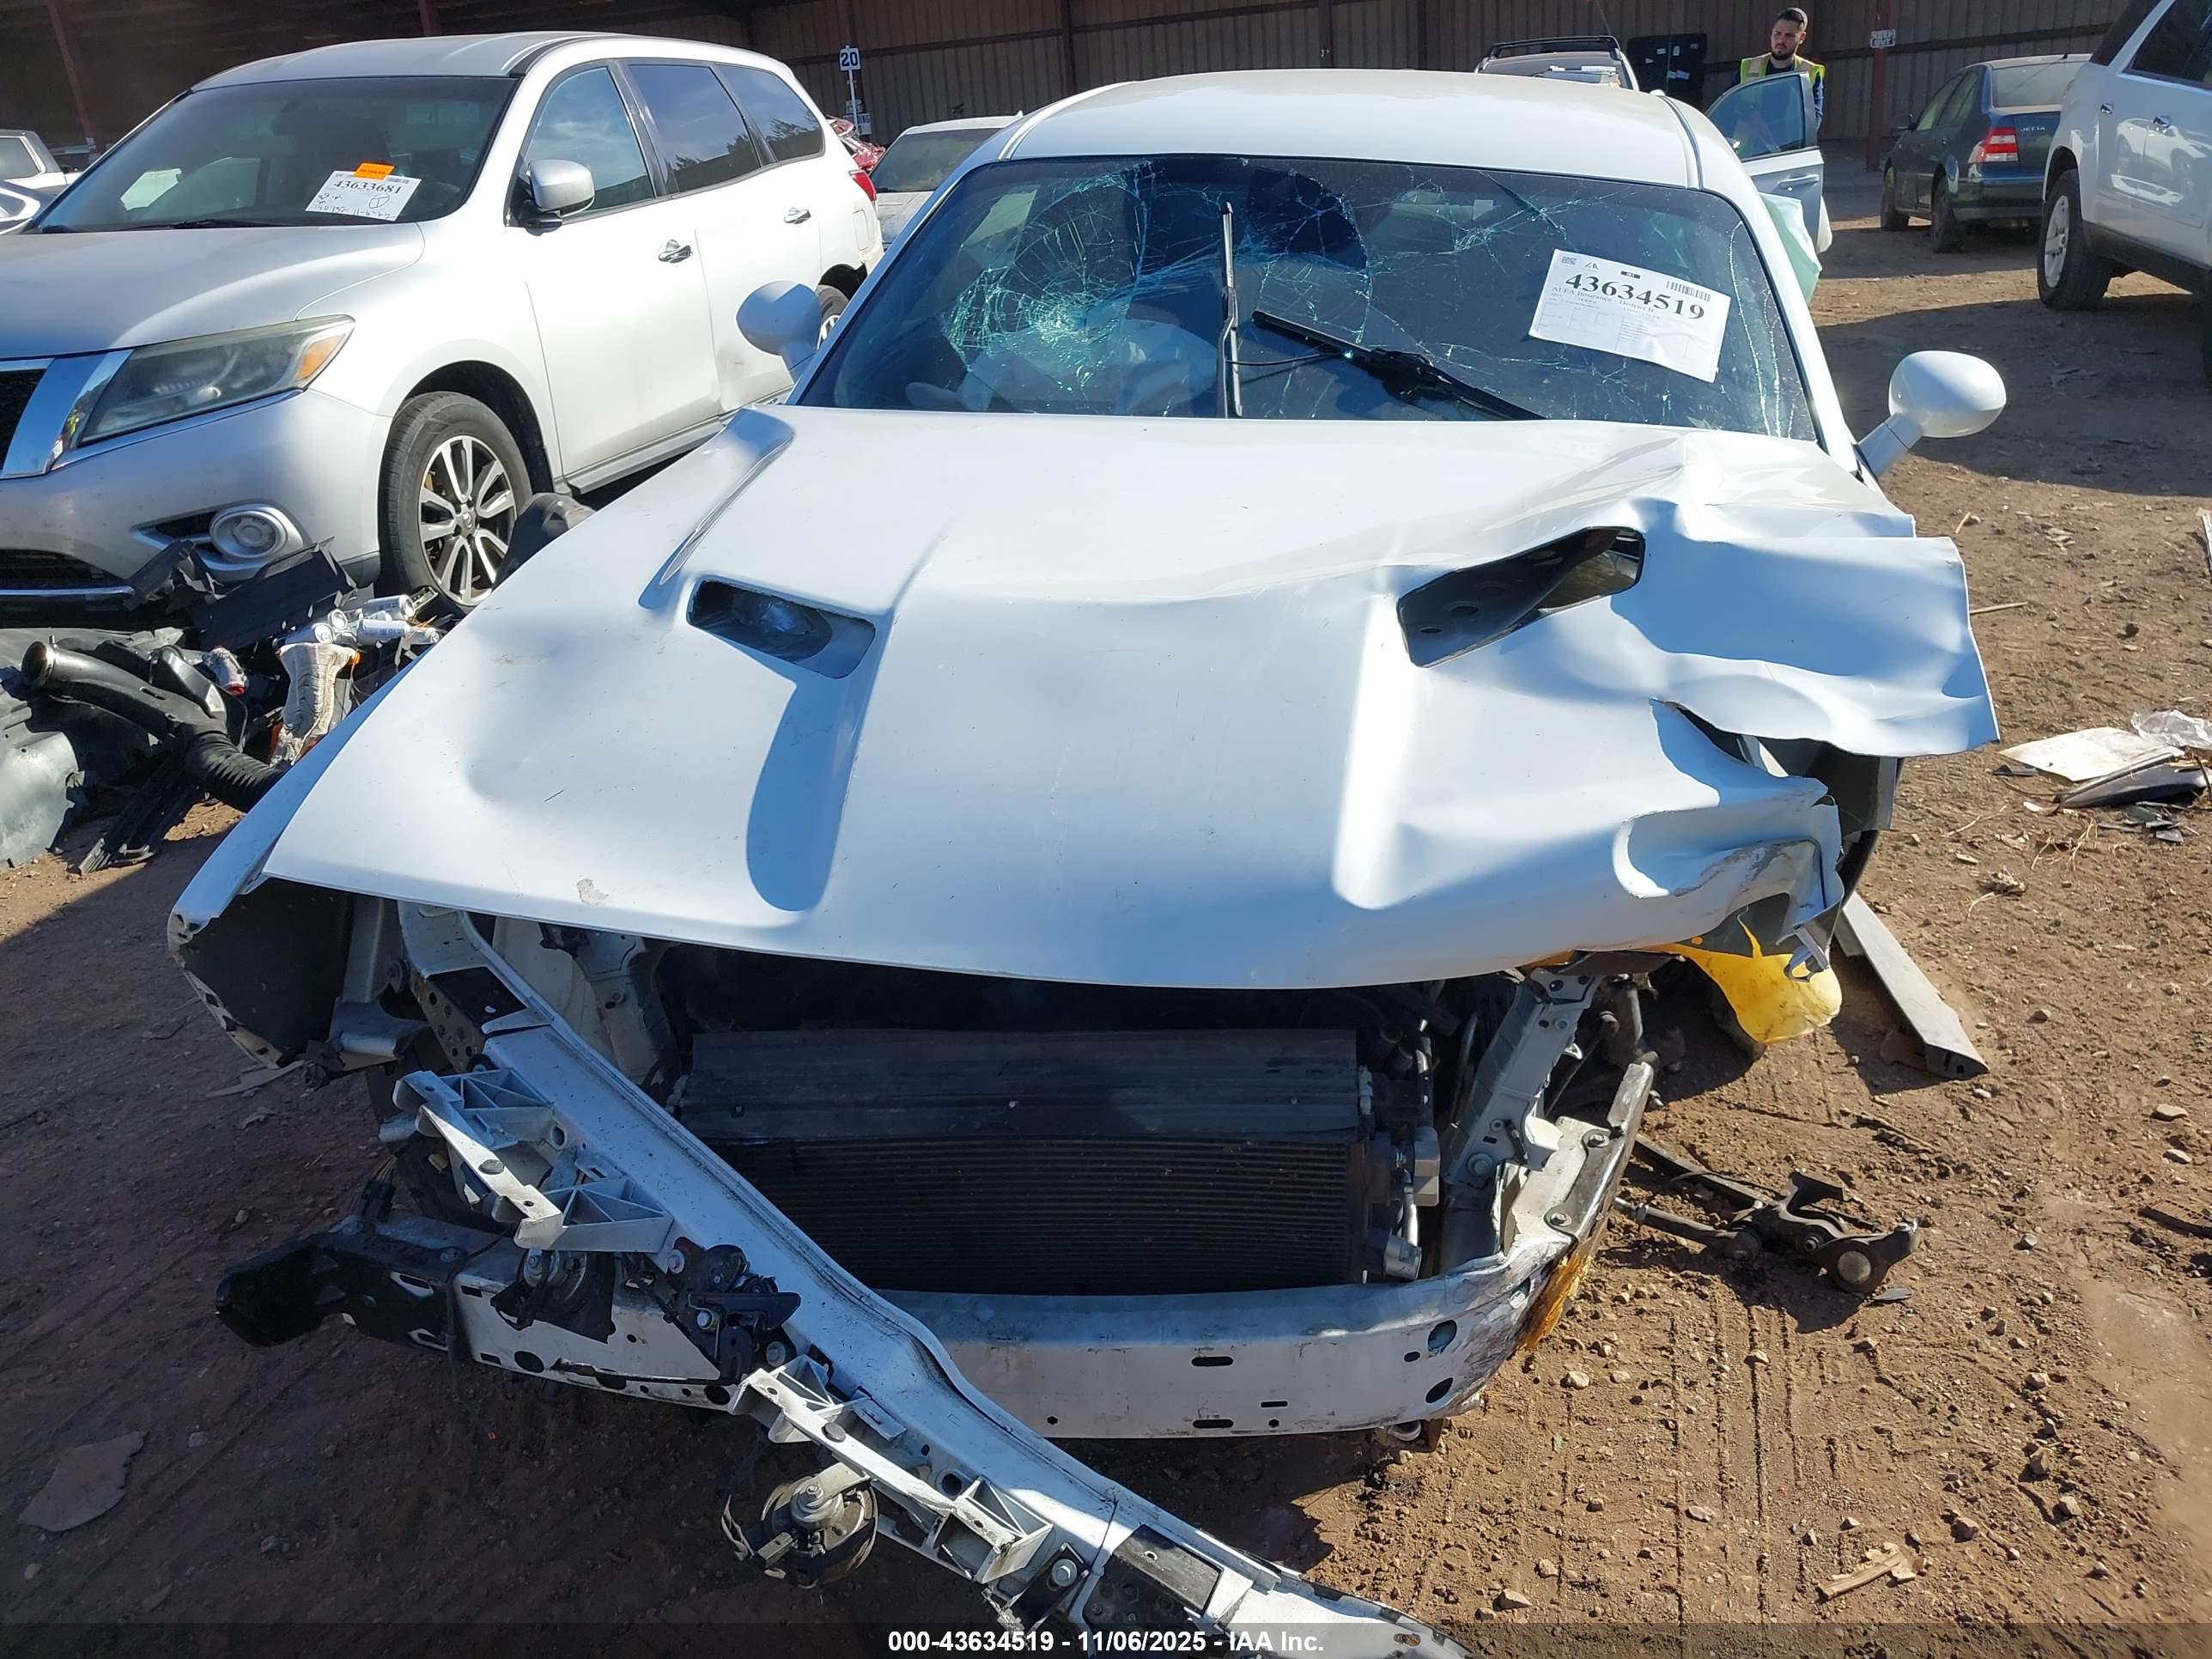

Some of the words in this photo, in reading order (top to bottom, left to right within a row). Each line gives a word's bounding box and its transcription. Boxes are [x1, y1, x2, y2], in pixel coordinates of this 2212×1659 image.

[842, 52, 859, 67] 20
[333, 179, 402, 195] 43633681
[1565, 274, 1705, 319] 43634519
